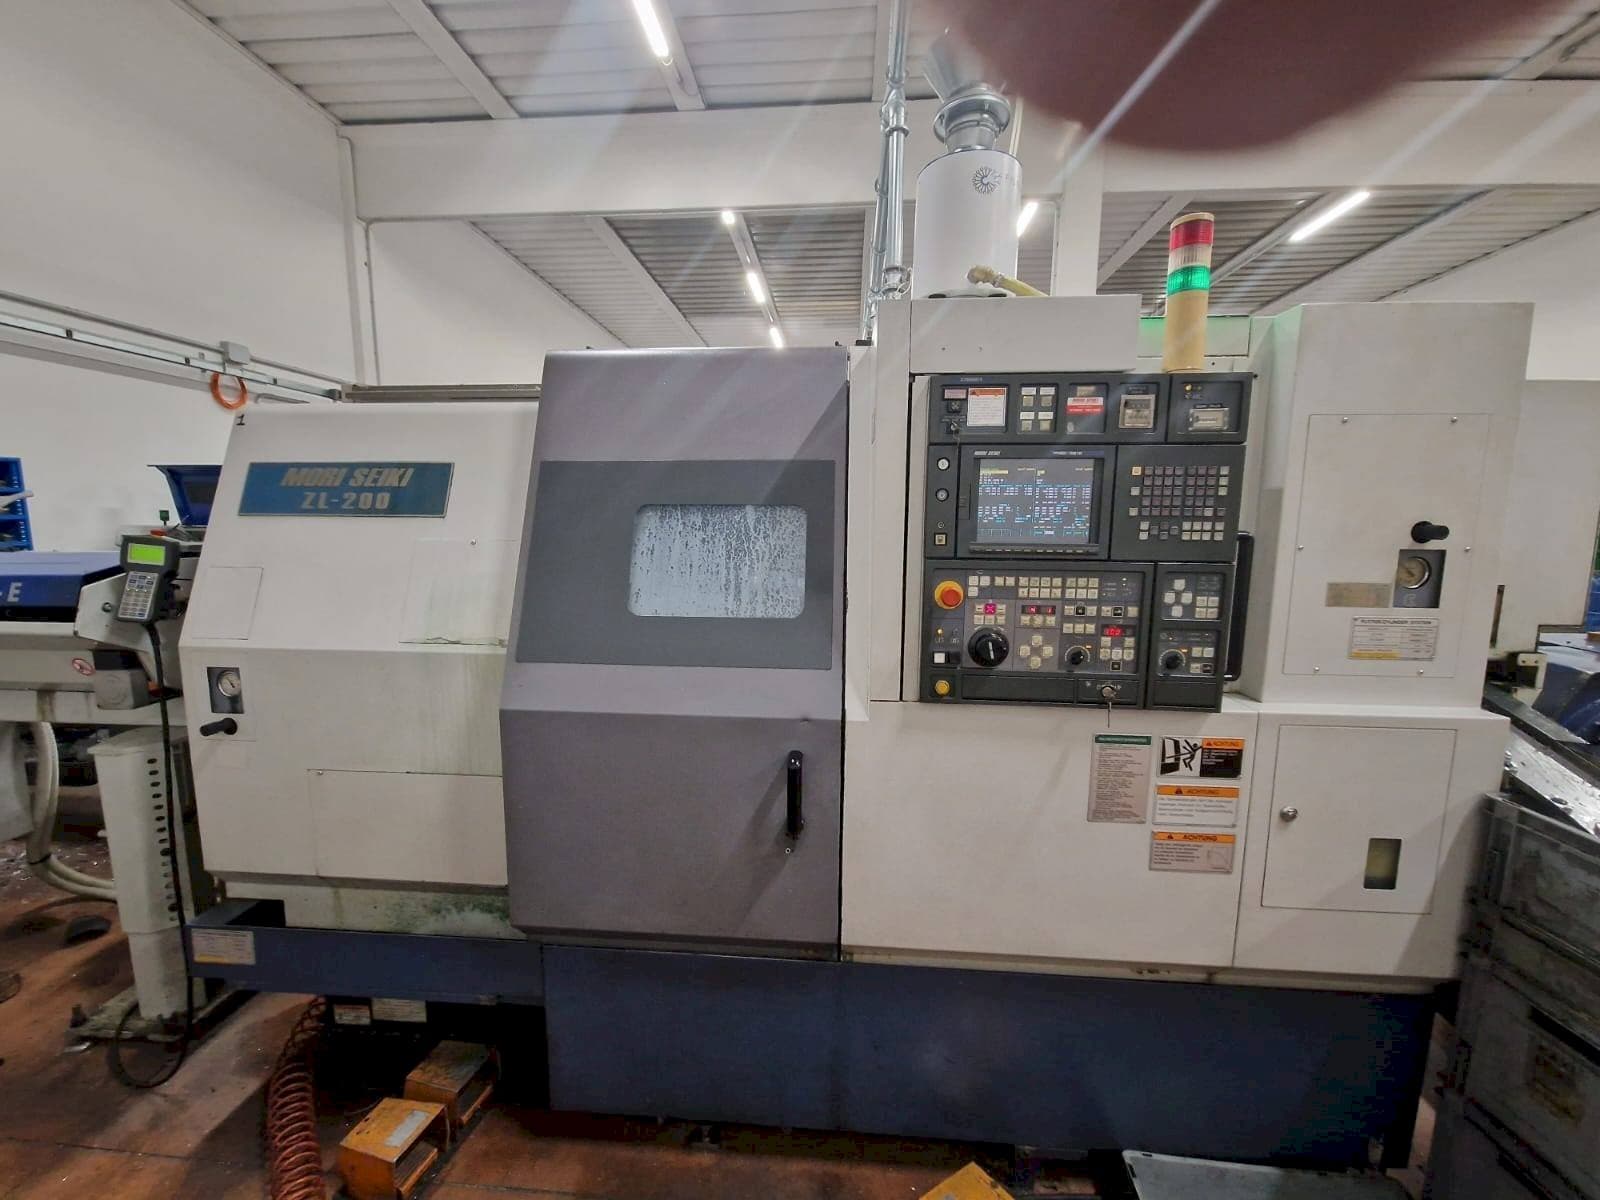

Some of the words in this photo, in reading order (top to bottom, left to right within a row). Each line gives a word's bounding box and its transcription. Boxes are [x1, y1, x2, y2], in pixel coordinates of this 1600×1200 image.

[281, 467, 347, 486] MORI
[349, 467, 415, 487] SEIKI
[301, 491, 391, 510] ZL-200
[1183, 833, 1218, 842] ACHTUNG
